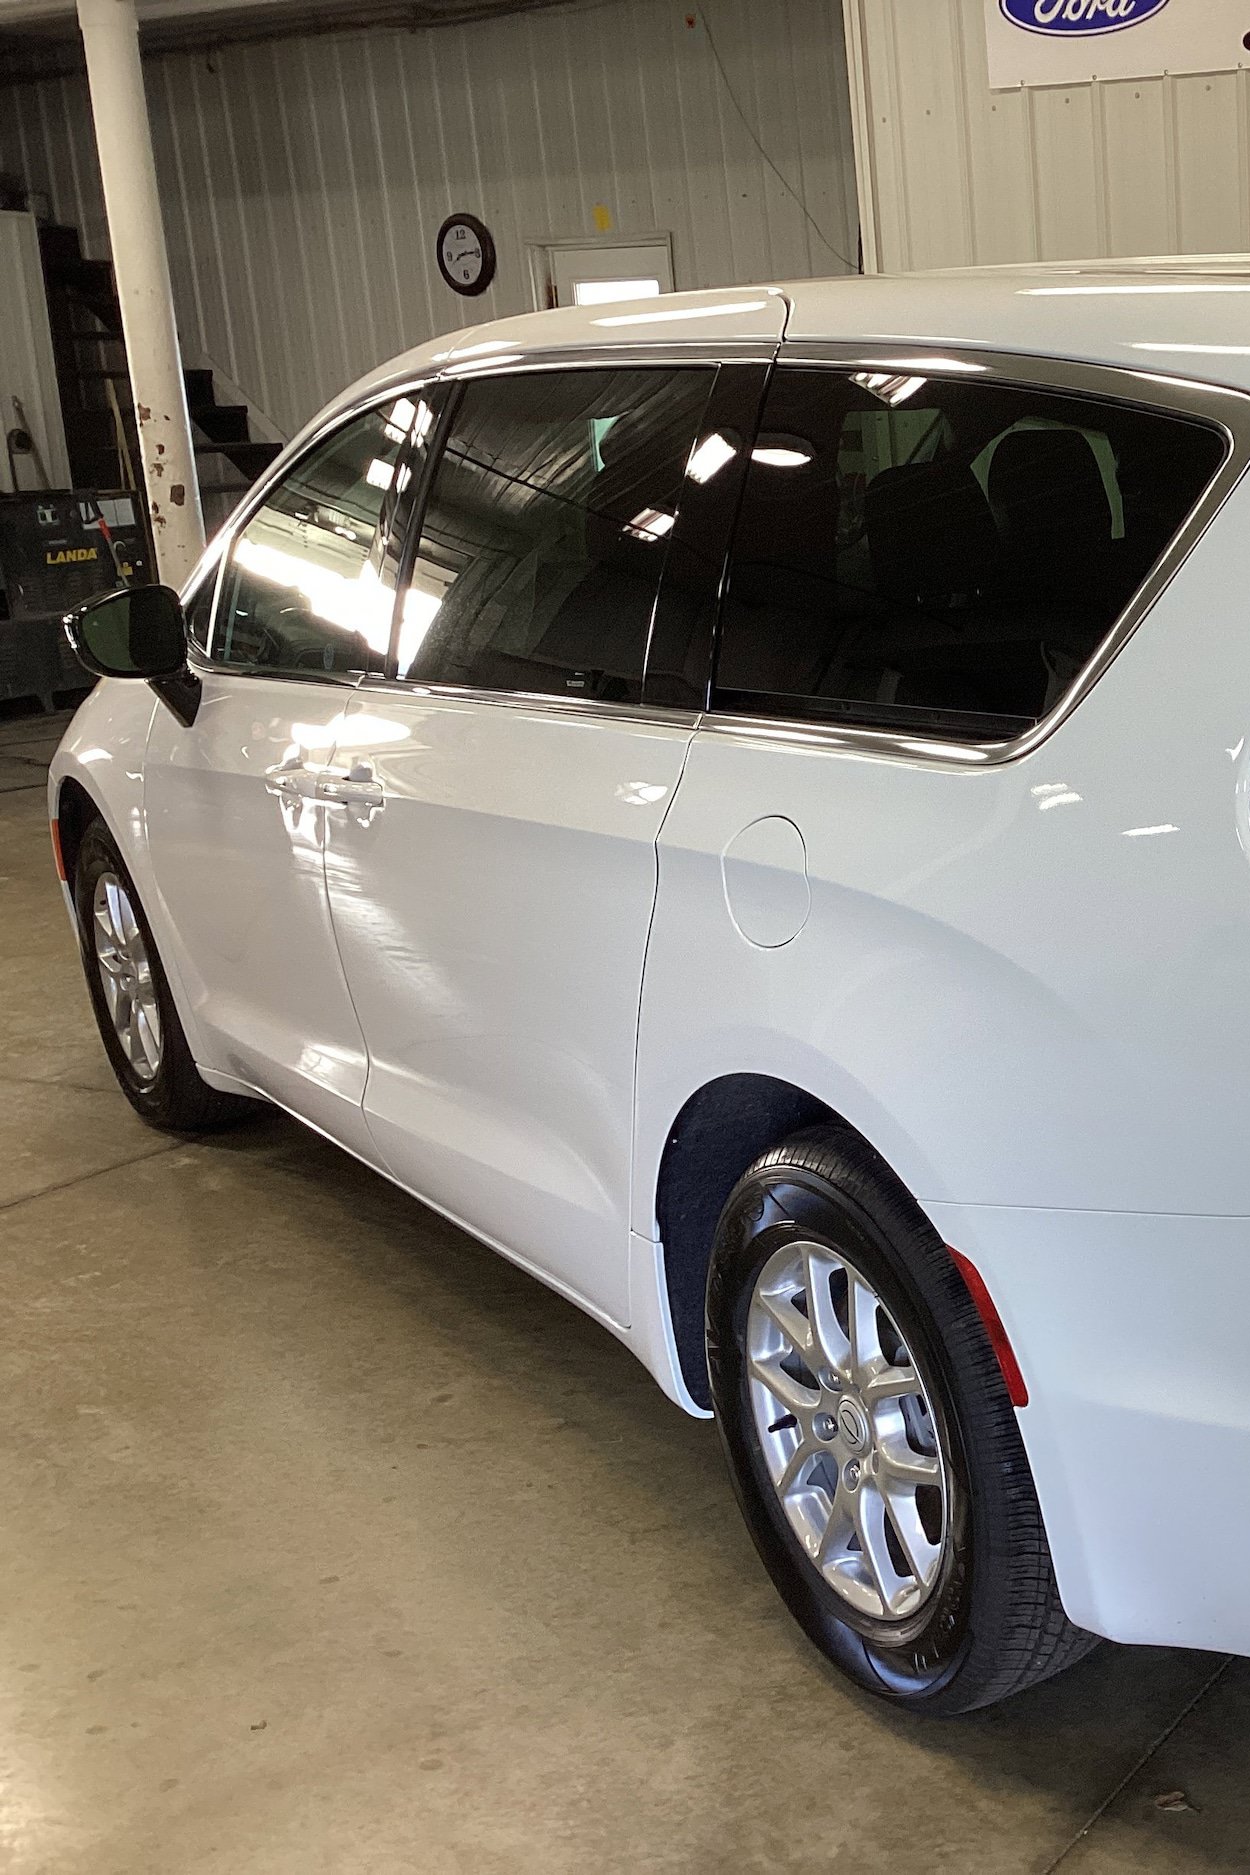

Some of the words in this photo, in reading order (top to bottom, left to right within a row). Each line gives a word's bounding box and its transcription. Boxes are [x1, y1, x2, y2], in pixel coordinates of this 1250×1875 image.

[455, 229, 466, 240] 12
[446, 251, 453, 262] 9
[463, 269, 470, 280] 6
[46, 548, 98, 565] LANDA
